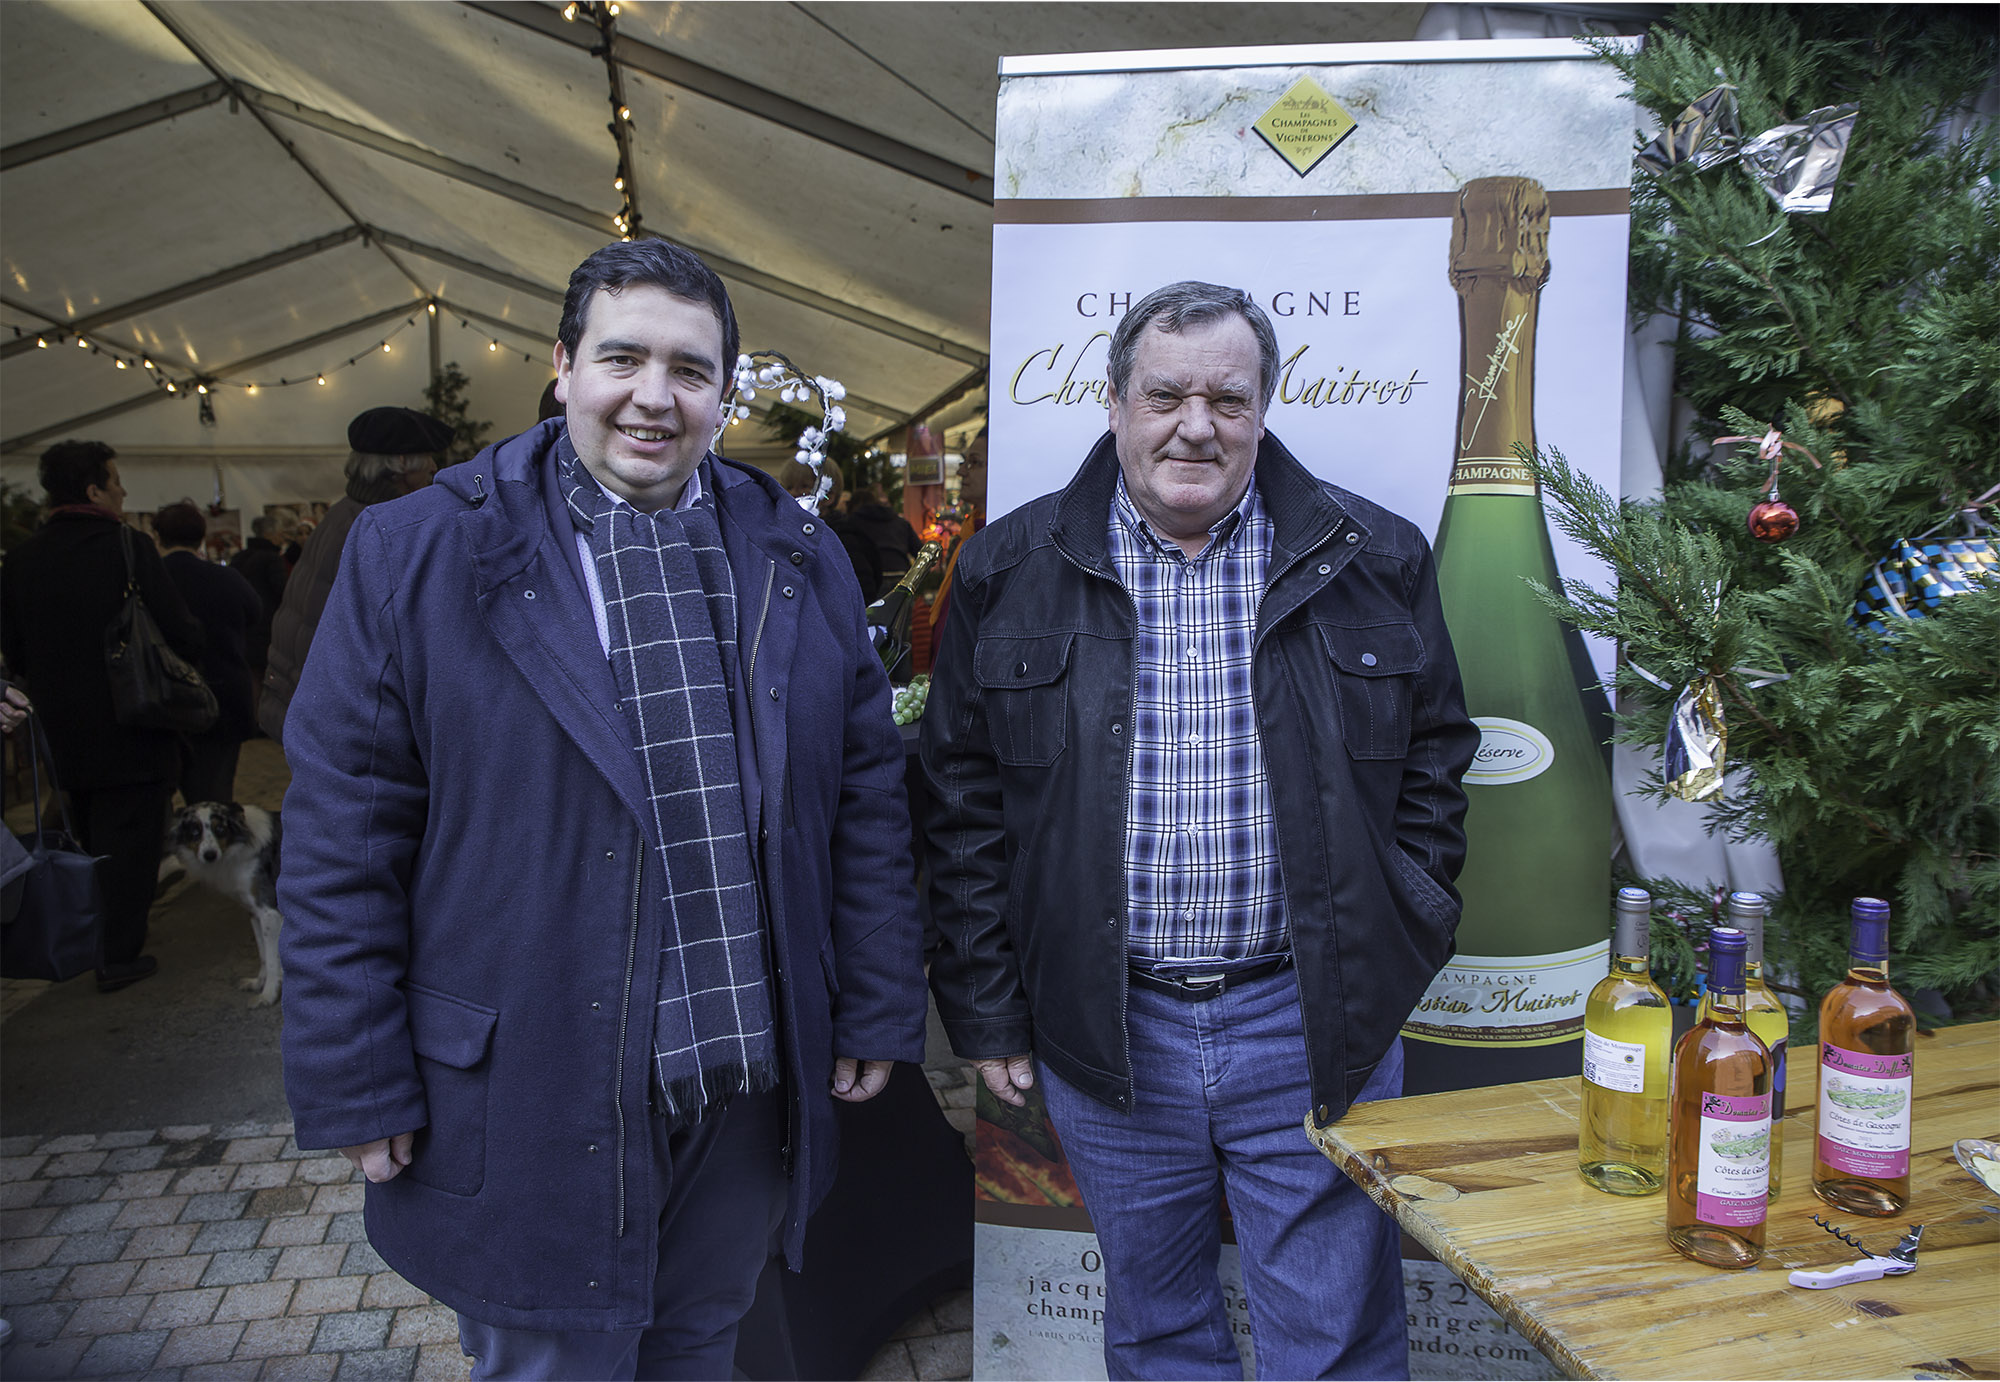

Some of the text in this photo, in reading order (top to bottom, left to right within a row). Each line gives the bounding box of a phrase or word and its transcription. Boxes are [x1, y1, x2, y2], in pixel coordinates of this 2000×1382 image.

[1455, 466, 1531, 481] HAMPAGNE
[1440, 973, 1538, 986] AMPAGNE
[1481, 987, 1583, 1013] Maitrot
[1853, 1119, 1863, 1127] de
[1714, 1164, 1740, 1176] Côtes
[1741, 1166, 1751, 1175] de
[1028, 1275, 1107, 1300] jacqu
[1027, 1298, 1105, 1325] champ
